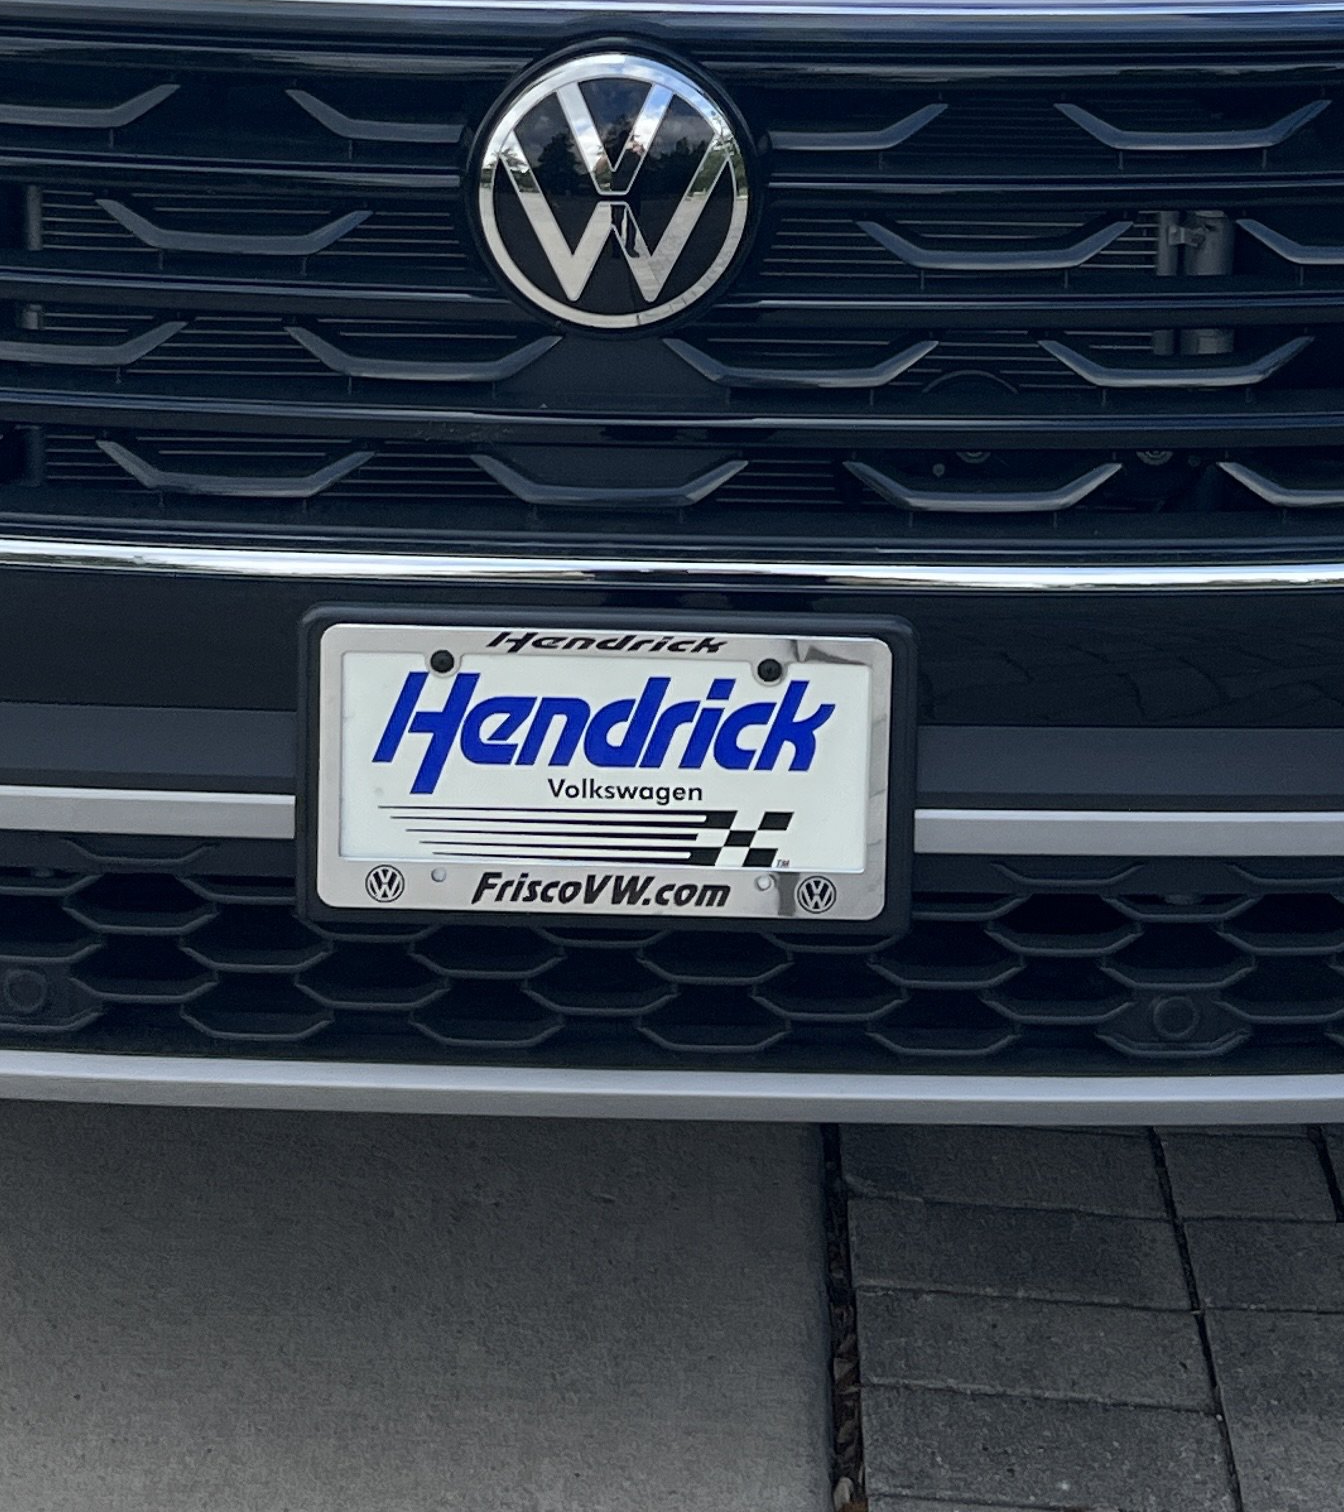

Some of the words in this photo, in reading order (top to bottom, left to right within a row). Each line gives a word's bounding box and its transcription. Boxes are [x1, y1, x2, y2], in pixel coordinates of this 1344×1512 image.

[486, 631, 728, 654] Hendrick
[372, 671, 836, 794] Hendrick
[548, 778, 703, 804] Volkswagen
[471, 871, 732, 908] FriscoVW.com
